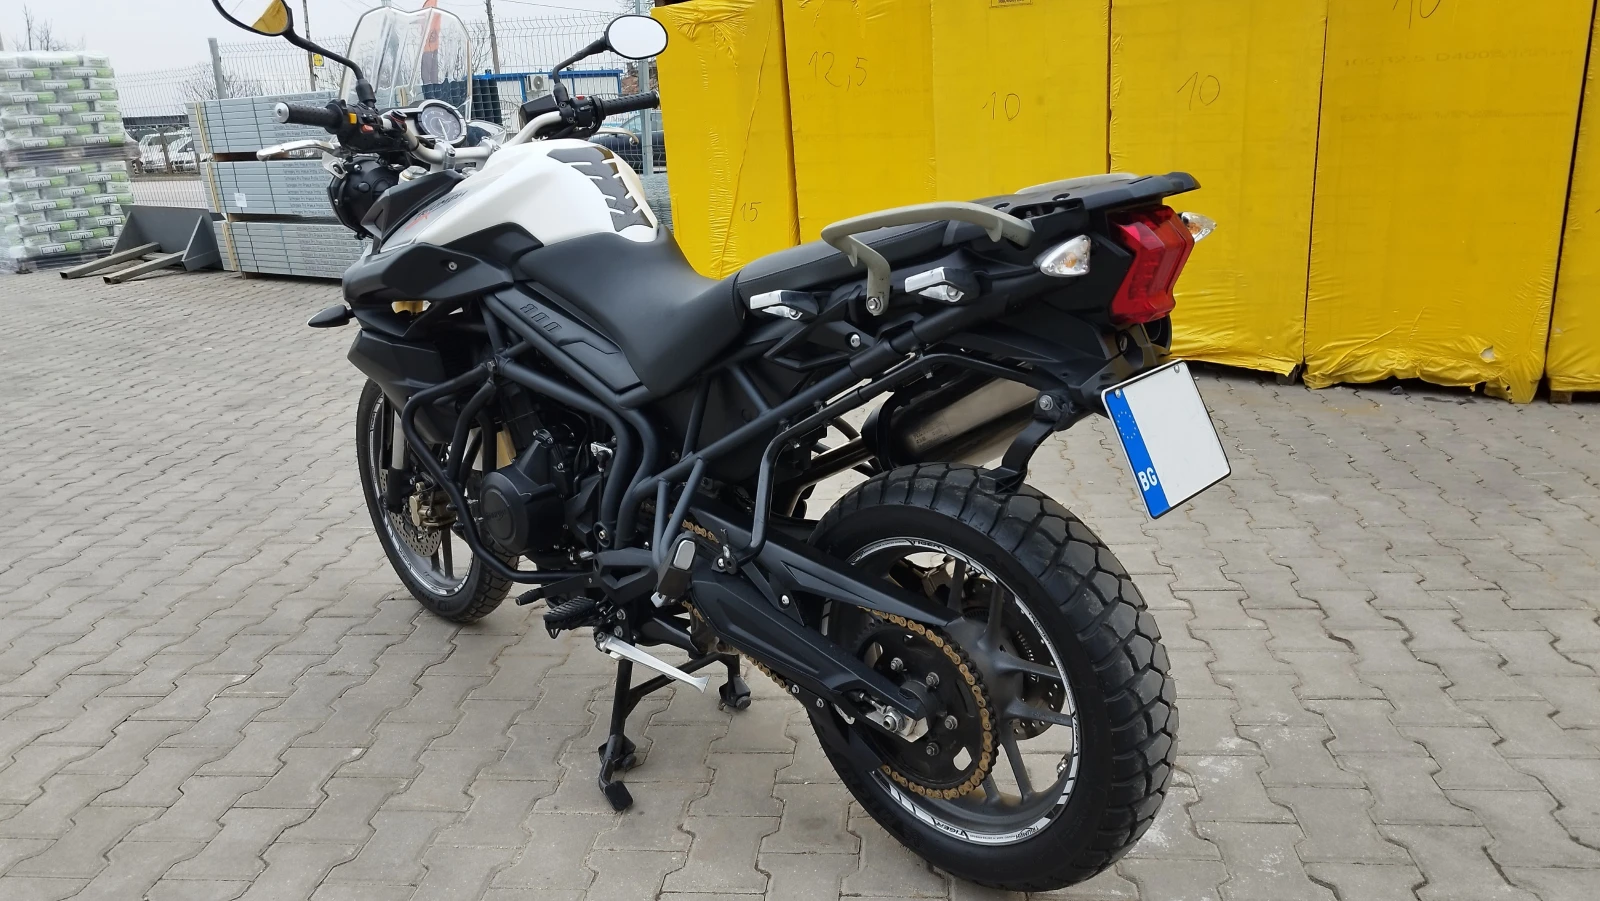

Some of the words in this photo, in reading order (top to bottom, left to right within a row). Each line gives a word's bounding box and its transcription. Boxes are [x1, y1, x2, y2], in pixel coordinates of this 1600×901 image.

[808, 51, 869, 92] 12,5
[1176, 71, 1221, 111] 10
[982, 91, 1021, 122] 10
[739, 201, 762, 223] 15
[519, 303, 563, 333] 800
[1137, 466, 1158, 492] BG
[935, 821, 966, 837] TIGER
